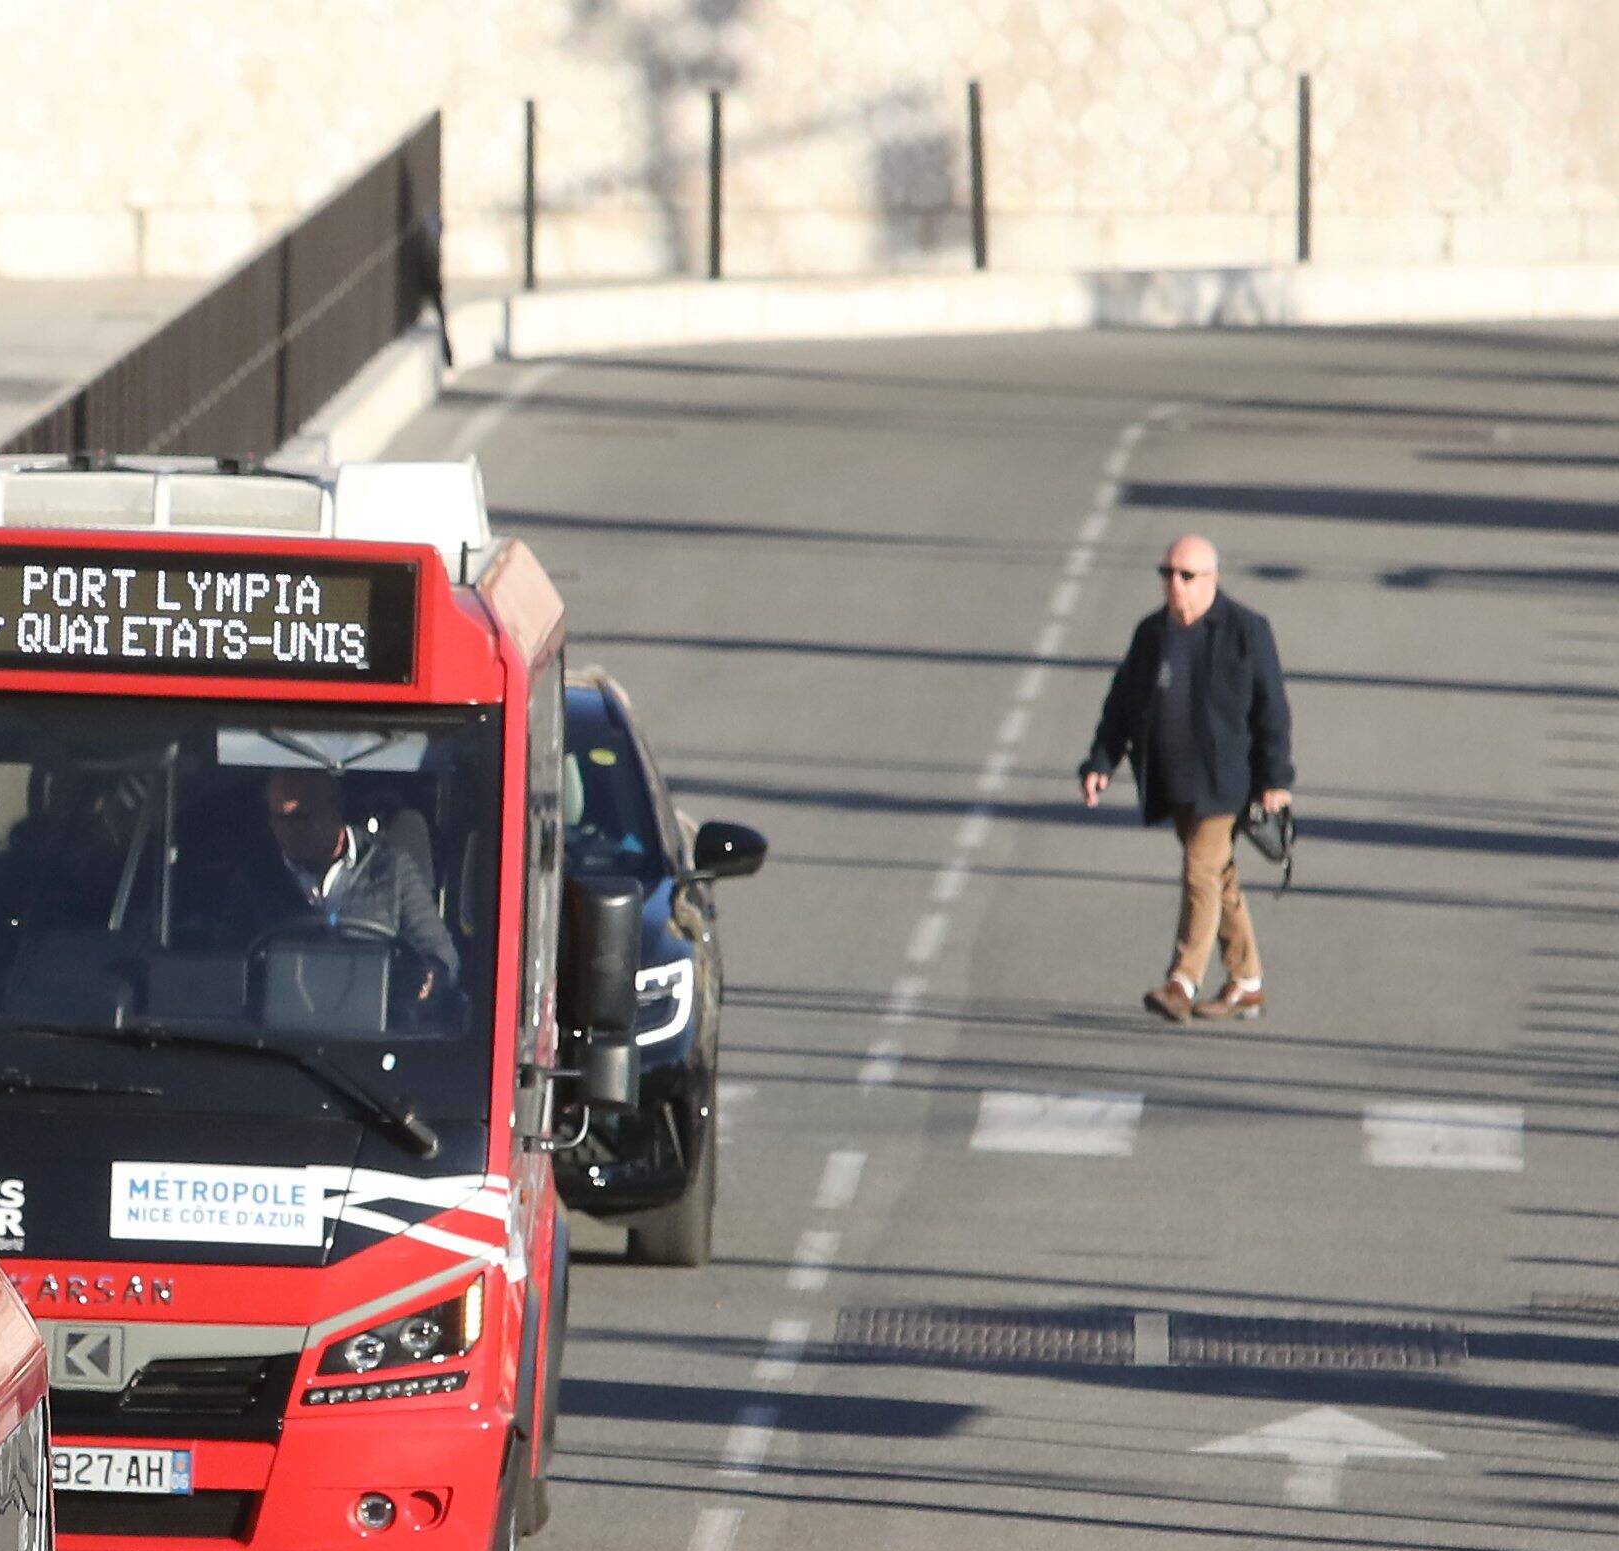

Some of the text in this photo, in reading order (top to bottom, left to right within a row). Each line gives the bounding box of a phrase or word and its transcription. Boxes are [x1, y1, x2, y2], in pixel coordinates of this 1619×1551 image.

[22, 565, 321, 616] PORT LYMPIA
[16, 612, 110, 656] QUAI
[121, 614, 365, 664] ETATS-UNIS
[128, 1172, 306, 1206] MÉTROPOLE
[127, 1205, 306, 1228] NICE CÔTE D'AZUR
